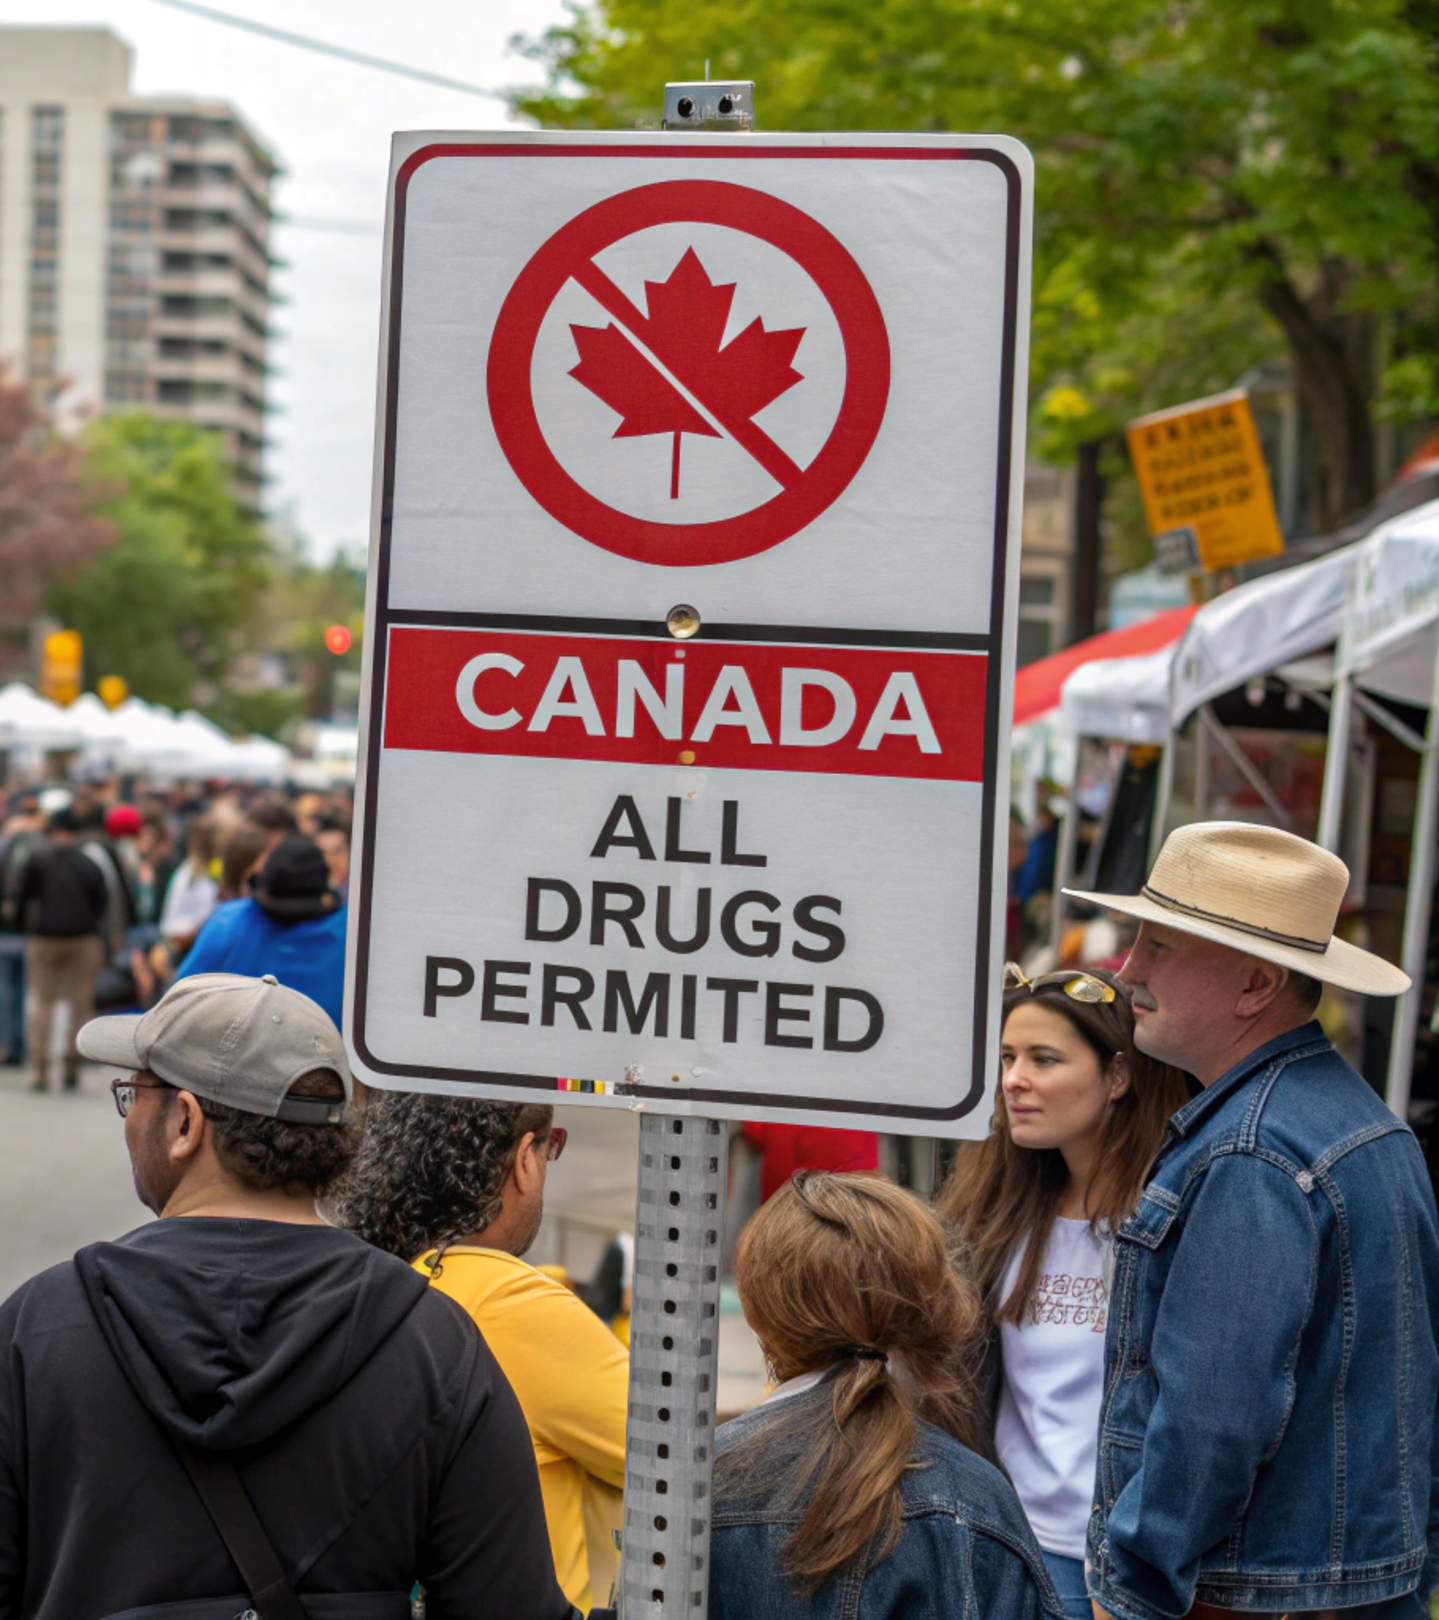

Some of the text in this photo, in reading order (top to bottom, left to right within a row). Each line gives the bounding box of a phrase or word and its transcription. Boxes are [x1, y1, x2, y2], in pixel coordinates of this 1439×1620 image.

[455, 652, 942, 754] CANADA
[589, 794, 768, 868] ALL
[524, 876, 846, 963] DRUGS
[423, 955, 885, 1053] PERMITED
